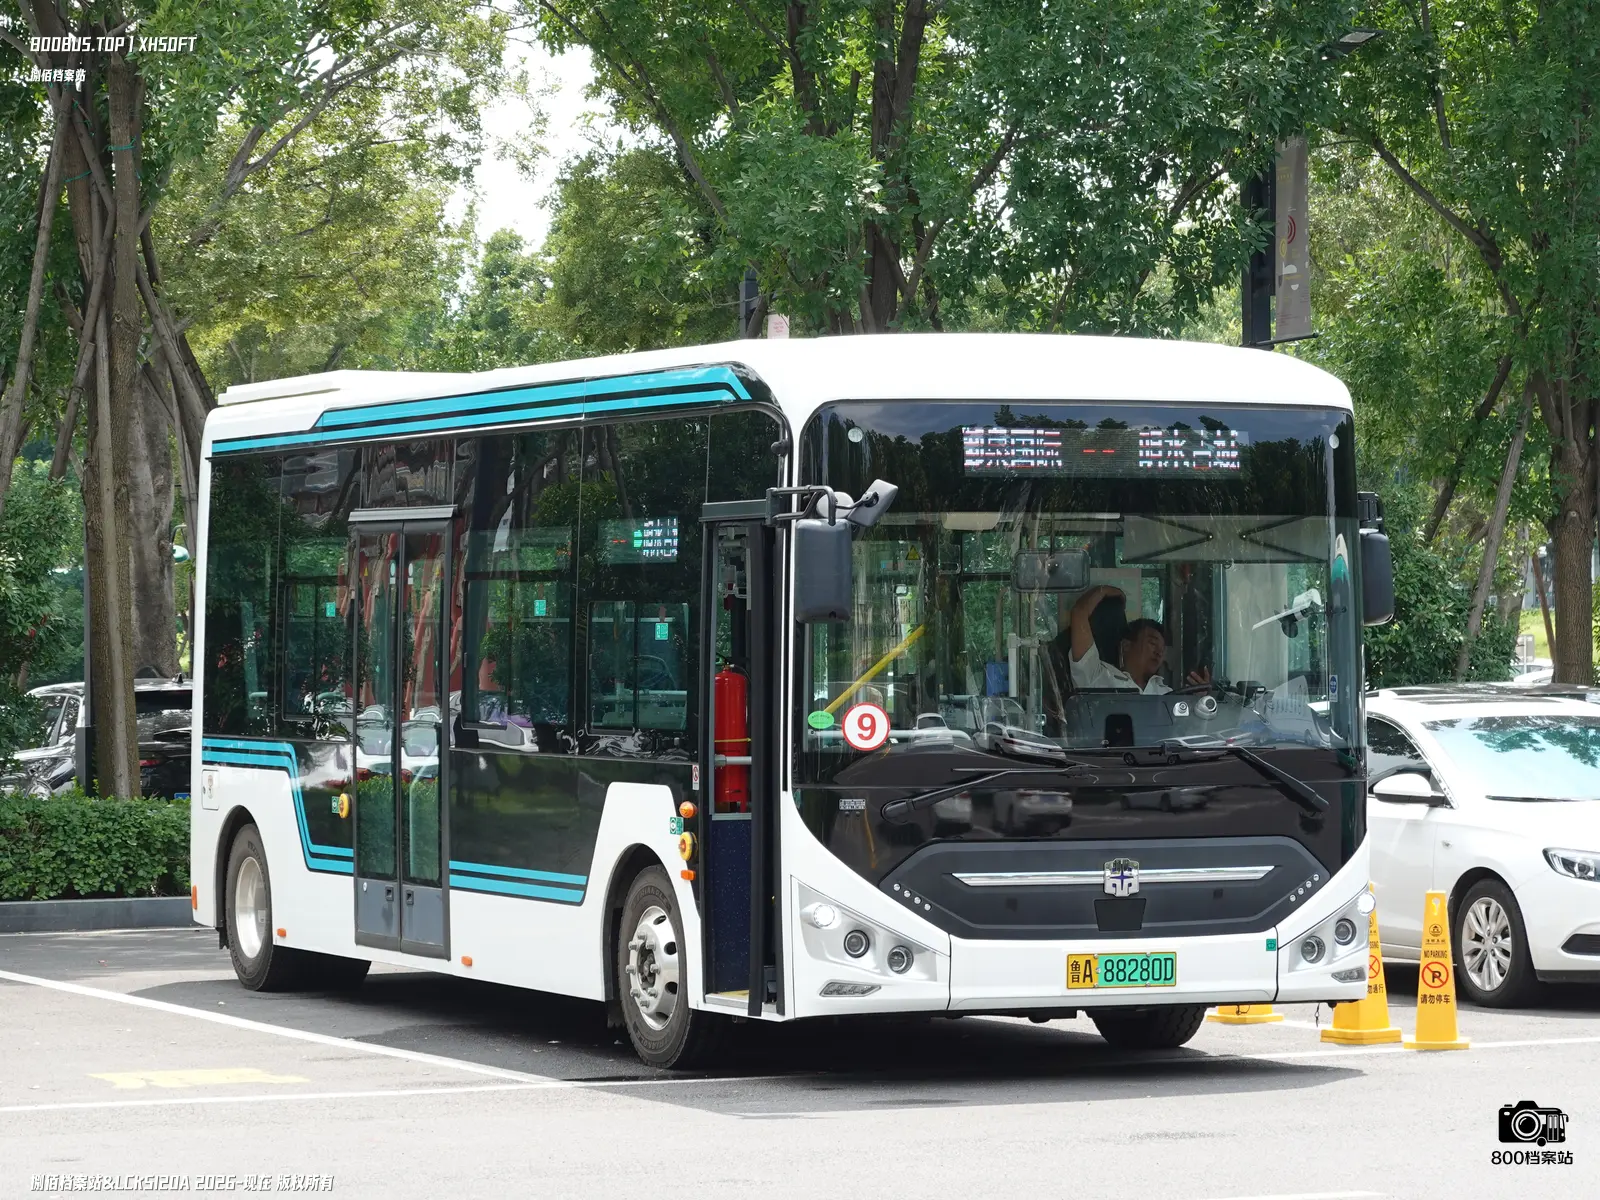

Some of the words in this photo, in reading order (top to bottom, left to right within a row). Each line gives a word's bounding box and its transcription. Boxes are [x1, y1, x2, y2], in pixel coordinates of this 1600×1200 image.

[857, 713, 877, 741] 9
[1070, 960, 1093, 983] 鲁A
[1104, 957, 1174, 982] 88280D
[1420, 994, 1451, 1004] 请勿停车
